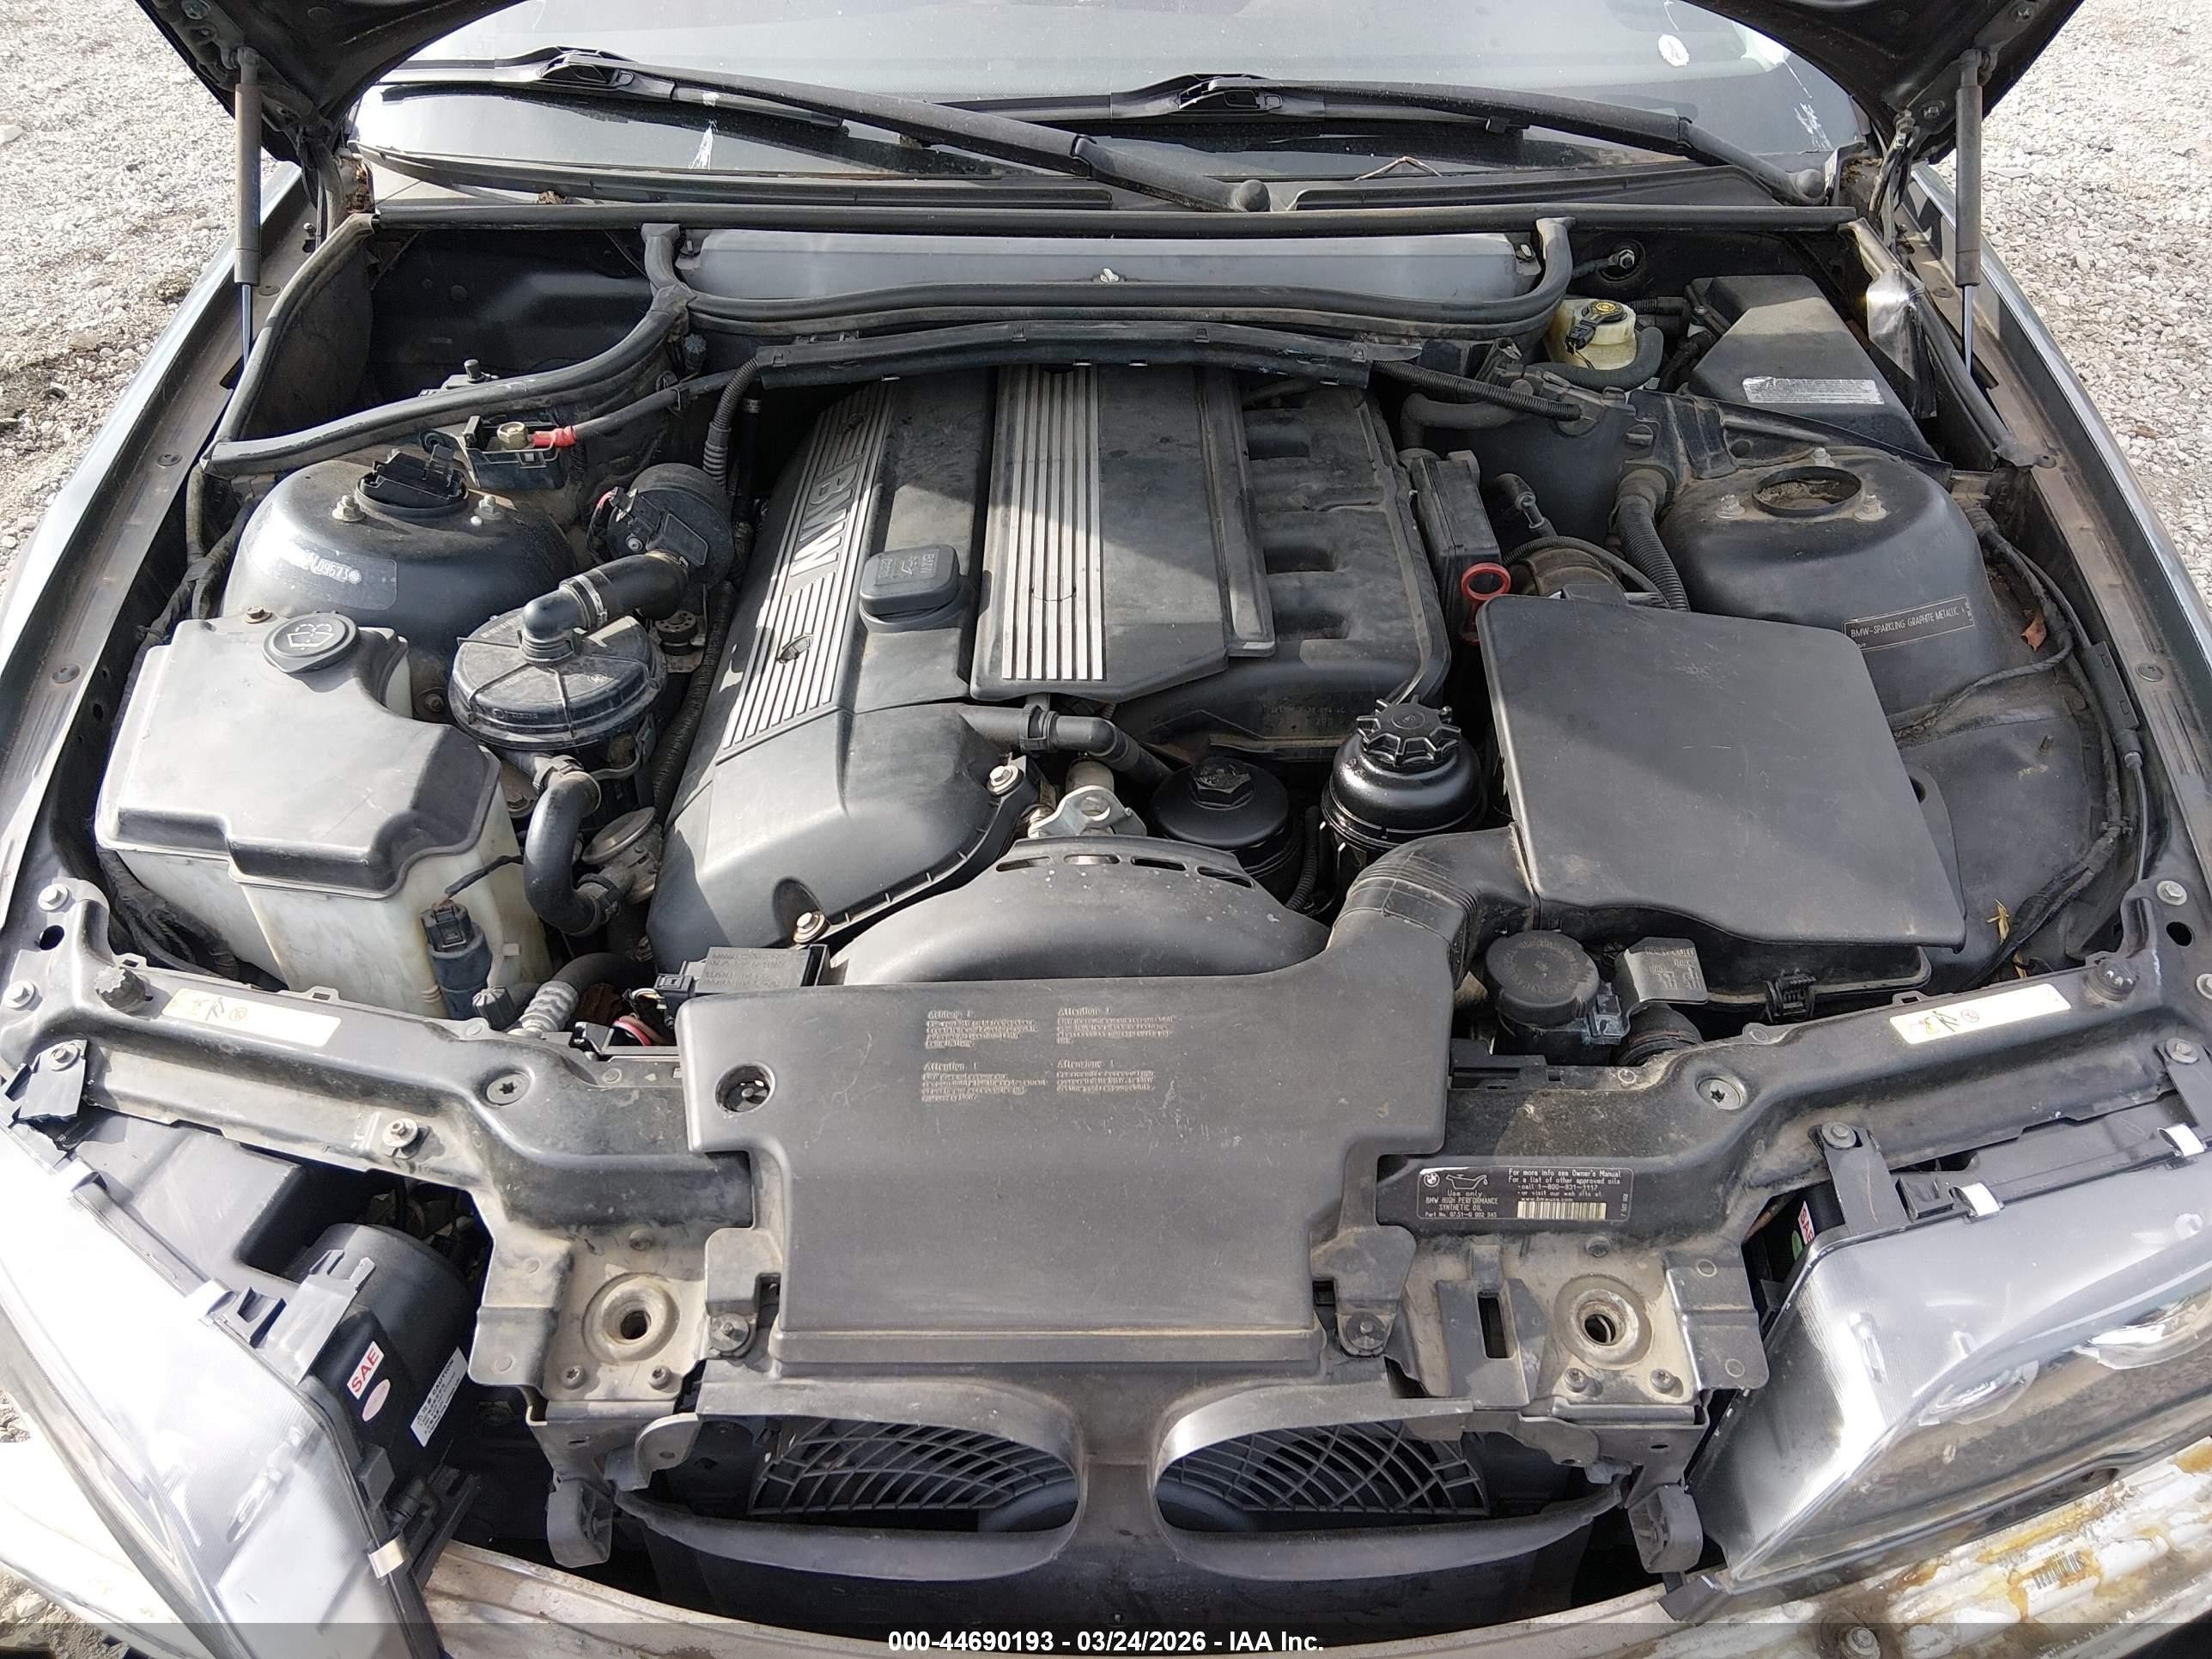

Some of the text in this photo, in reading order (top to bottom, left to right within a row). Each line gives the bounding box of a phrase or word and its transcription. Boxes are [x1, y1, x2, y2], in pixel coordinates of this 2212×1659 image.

[790, 461, 860, 578] BMW
[1850, 620, 1906, 638] BMW-SPARKLING
[1907, 611, 1935, 627] GRAPHITE
[1508, 1168, 1520, 1176] For
[1571, 1169, 1596, 1177] Owner's
[1599, 1170, 1622, 1178] Manual
[1447, 1188, 1483, 1198] Use only
[351, 1348, 380, 1393] SAE
[433, 1359, 454, 1395] CAUTION
